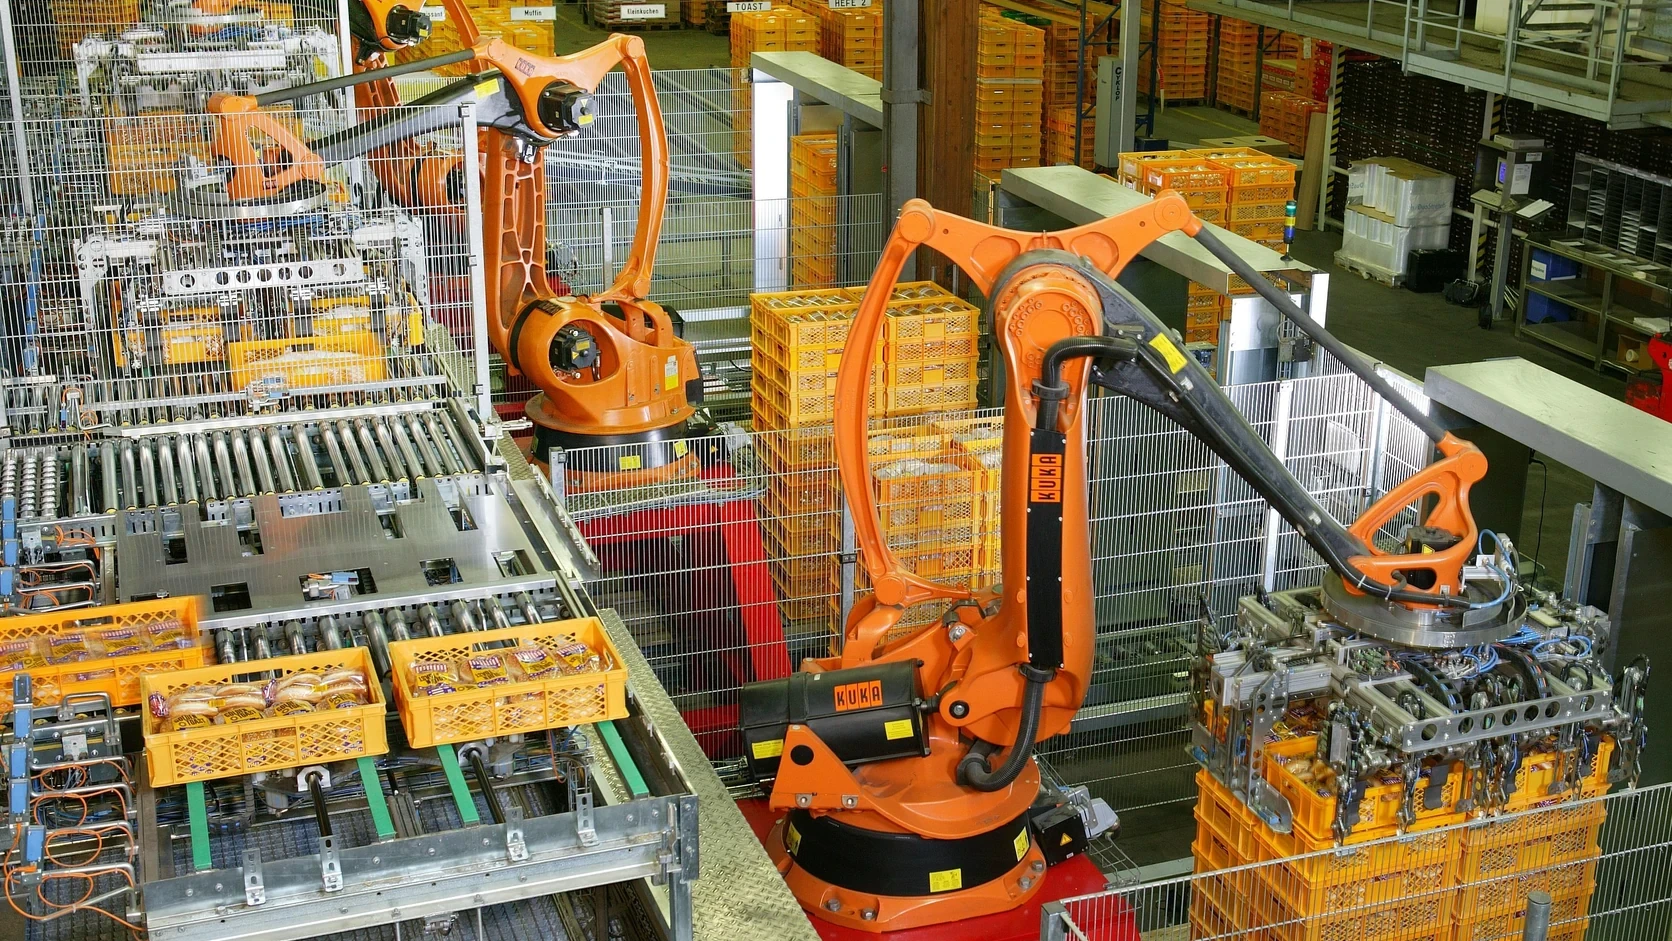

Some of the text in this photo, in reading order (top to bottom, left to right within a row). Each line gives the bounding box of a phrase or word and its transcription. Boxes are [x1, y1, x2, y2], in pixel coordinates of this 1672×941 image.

[735, 3, 764, 11] TOAST
[1038, 456, 1057, 500] KUKA
[836, 686, 881, 707] KUKA
